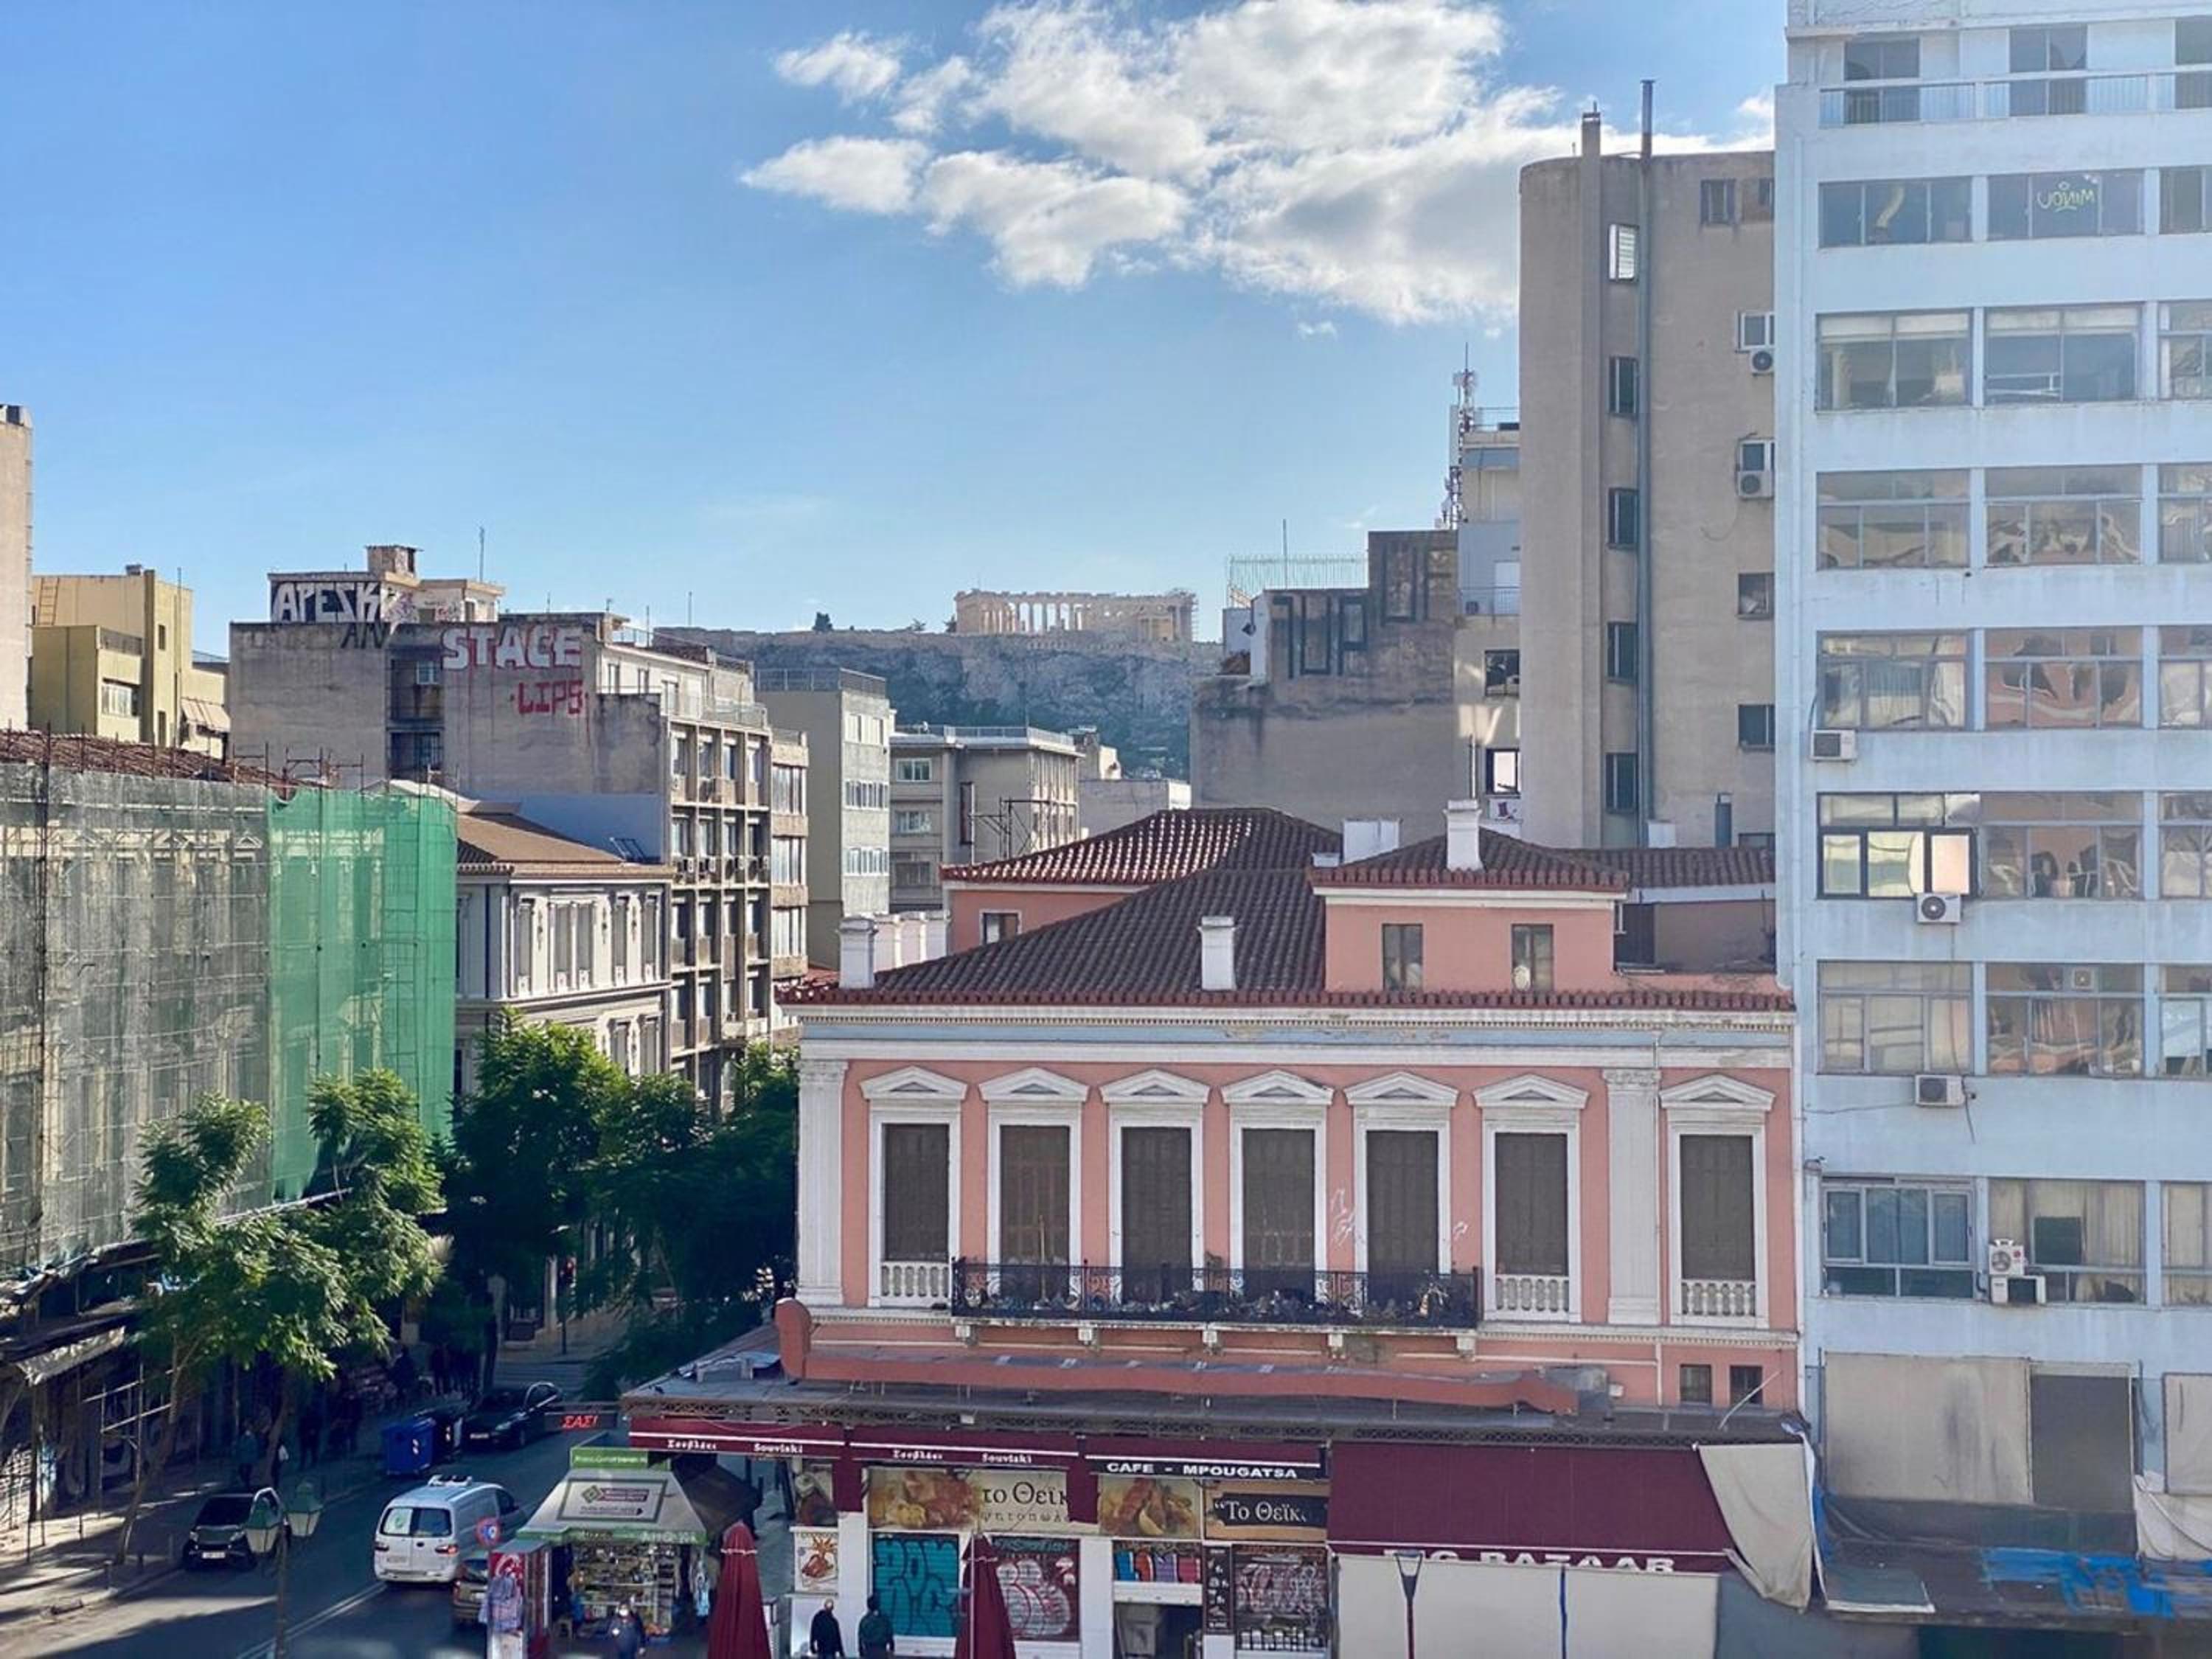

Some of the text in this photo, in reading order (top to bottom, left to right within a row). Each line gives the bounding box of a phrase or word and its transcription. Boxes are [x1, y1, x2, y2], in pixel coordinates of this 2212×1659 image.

[754, 1443, 803, 1453] Souvlaki
[981, 1453, 1032, 1464] Souvlaki
[1107, 1462, 1154, 1474] CAFE
[1183, 1464, 1298, 1479] MPOUGATSA
